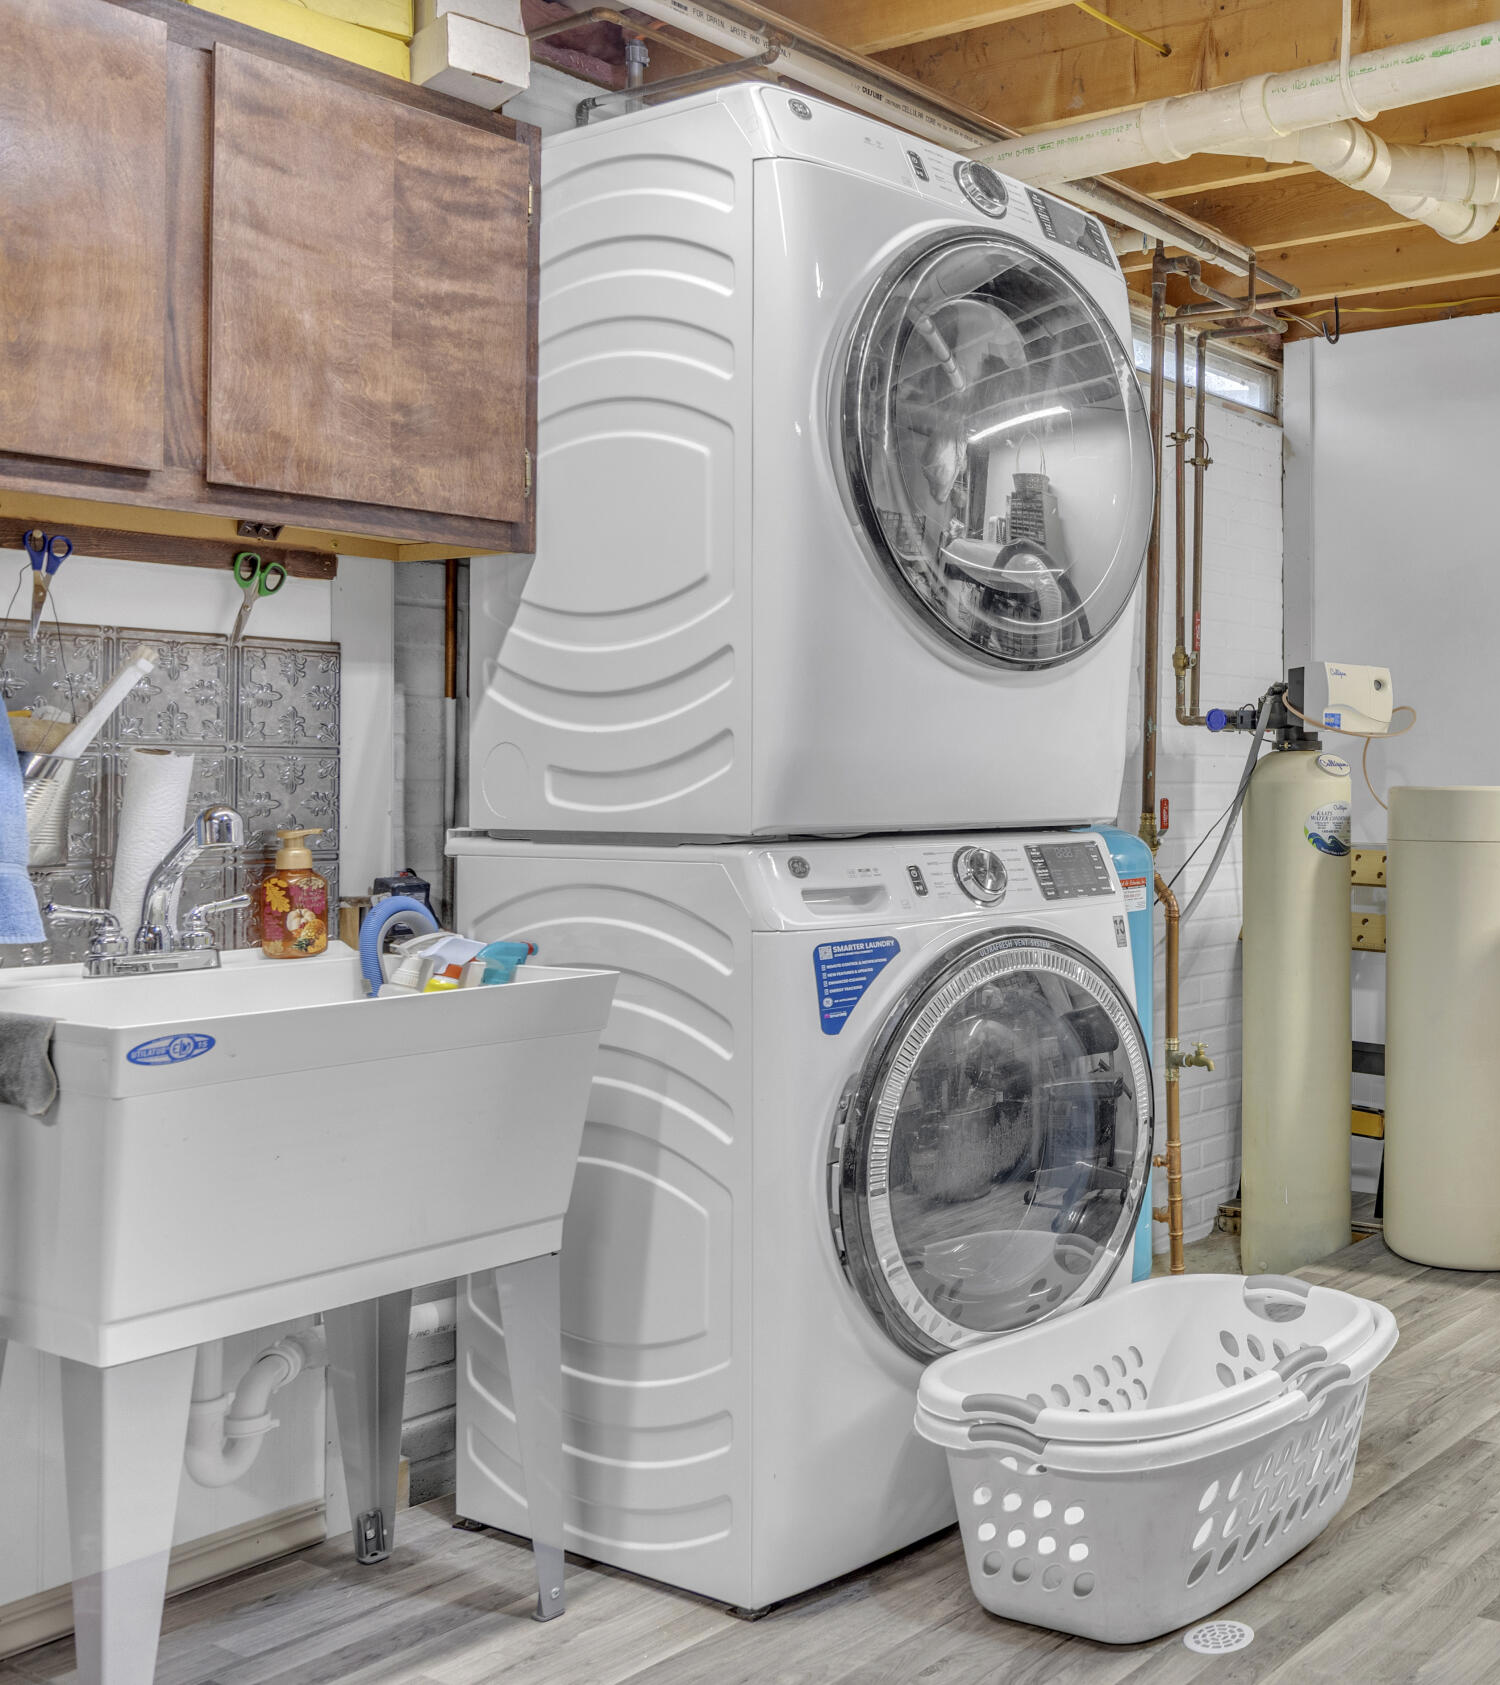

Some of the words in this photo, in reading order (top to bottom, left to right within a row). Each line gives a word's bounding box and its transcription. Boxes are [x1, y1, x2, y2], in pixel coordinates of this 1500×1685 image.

[692, 7, 704, 18] FOR
[730, 26, 748, 39] WASTE
[750, 33, 760, 45] AND
[1320, 759, 1349, 771] Culligan
[833, 943, 865, 953] SMARTER
[865, 940, 895, 949] LAUNDRY
[980, 940, 1013, 957] ULTRAFRESH
[1014, 939, 1028, 947] VENT
[1030, 940, 1049, 948] SYSTEM
